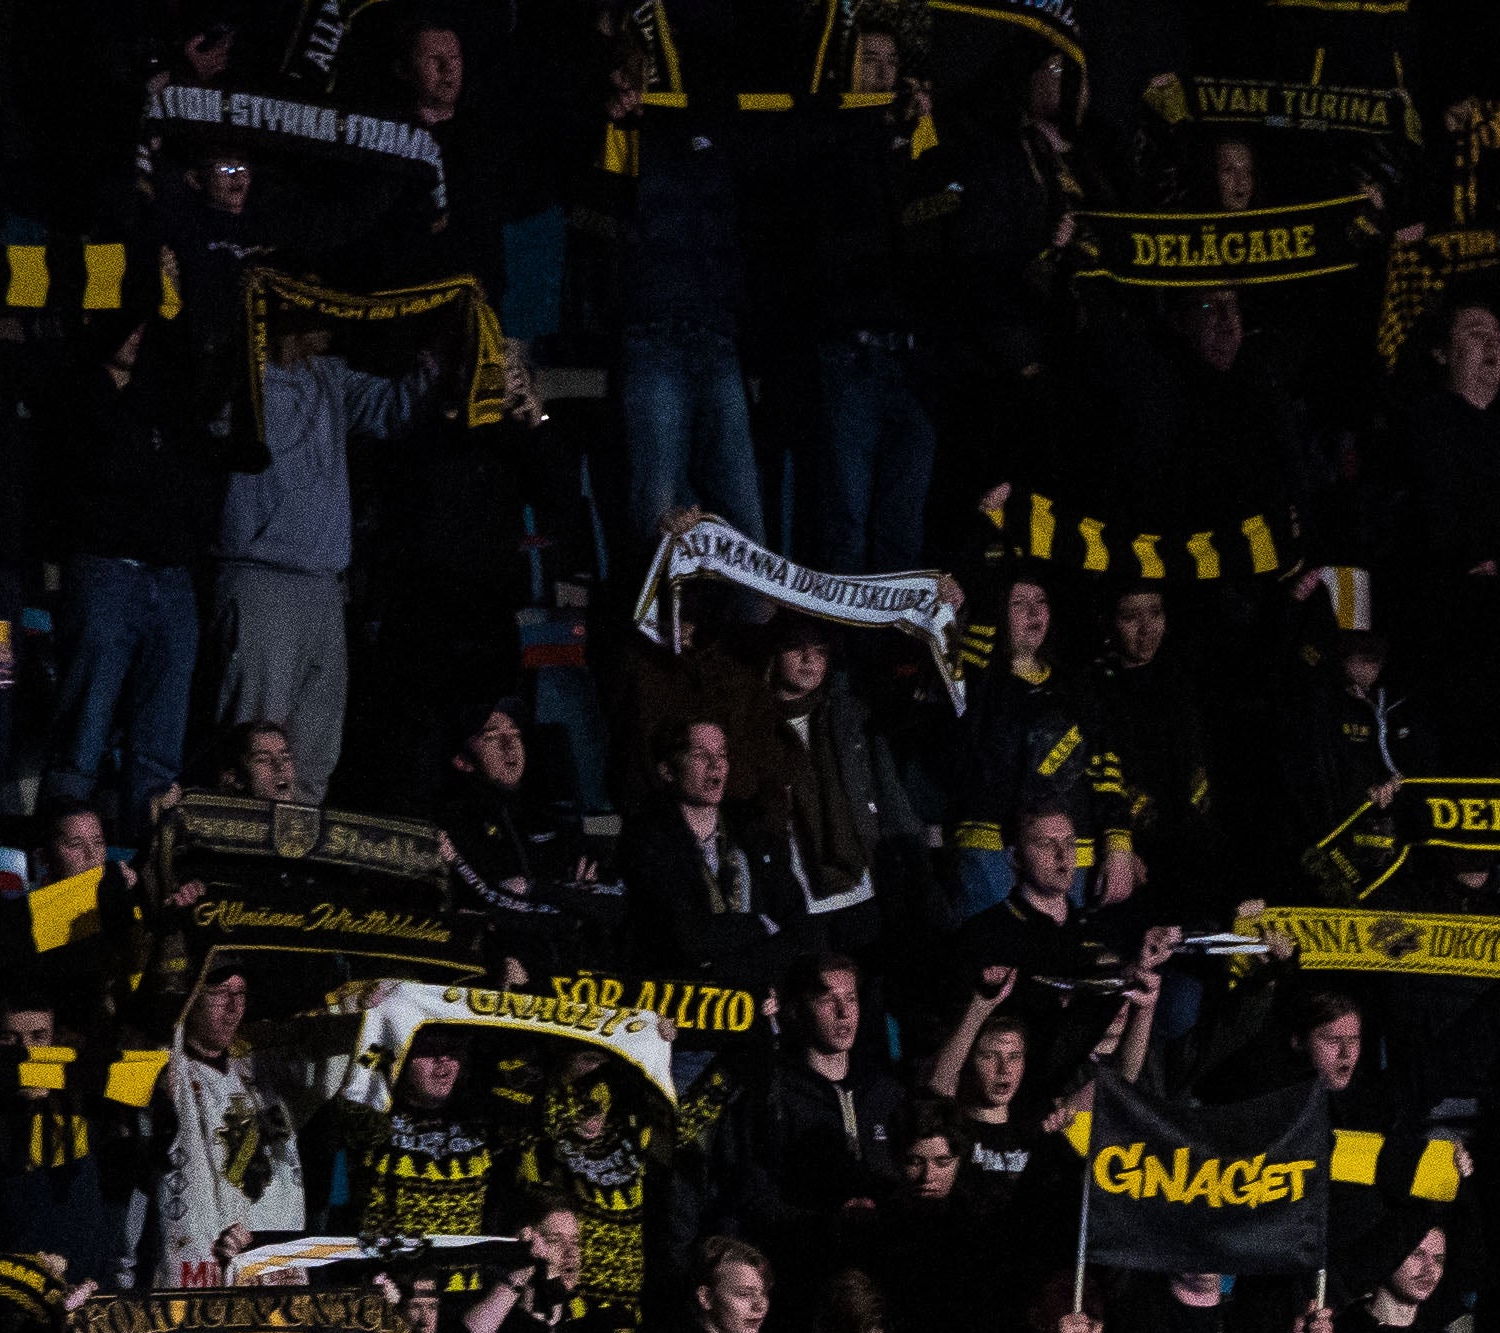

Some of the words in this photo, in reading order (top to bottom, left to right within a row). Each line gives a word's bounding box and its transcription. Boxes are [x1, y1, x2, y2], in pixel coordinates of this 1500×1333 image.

[1198, 83, 1269, 113] IVAN
[1283, 90, 1390, 126] TURINA
[1130, 224, 1317, 267] DELÄGARE
[1099, 1141, 1317, 1209] GNAGET
